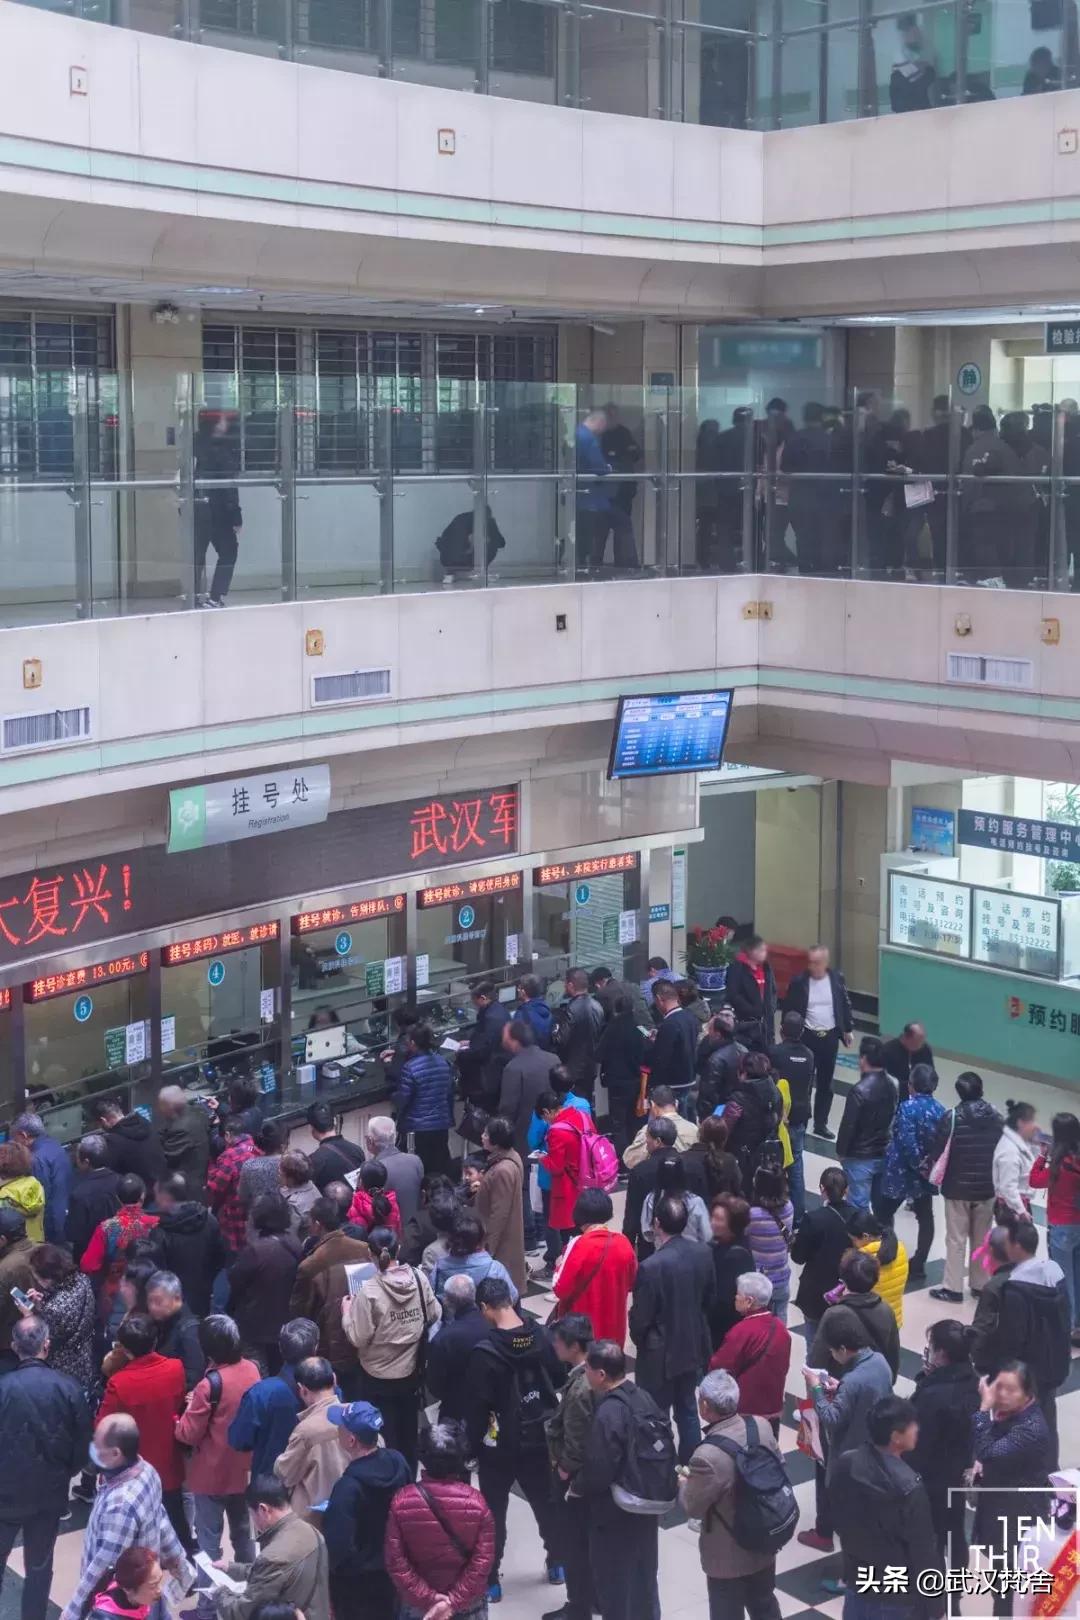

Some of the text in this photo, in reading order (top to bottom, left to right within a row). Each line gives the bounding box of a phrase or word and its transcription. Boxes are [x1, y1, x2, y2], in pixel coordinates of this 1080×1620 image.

[232, 777, 309, 816] 挂号处
[248, 813, 290, 829] Registration
[409, 792, 518, 859] 武汉军
